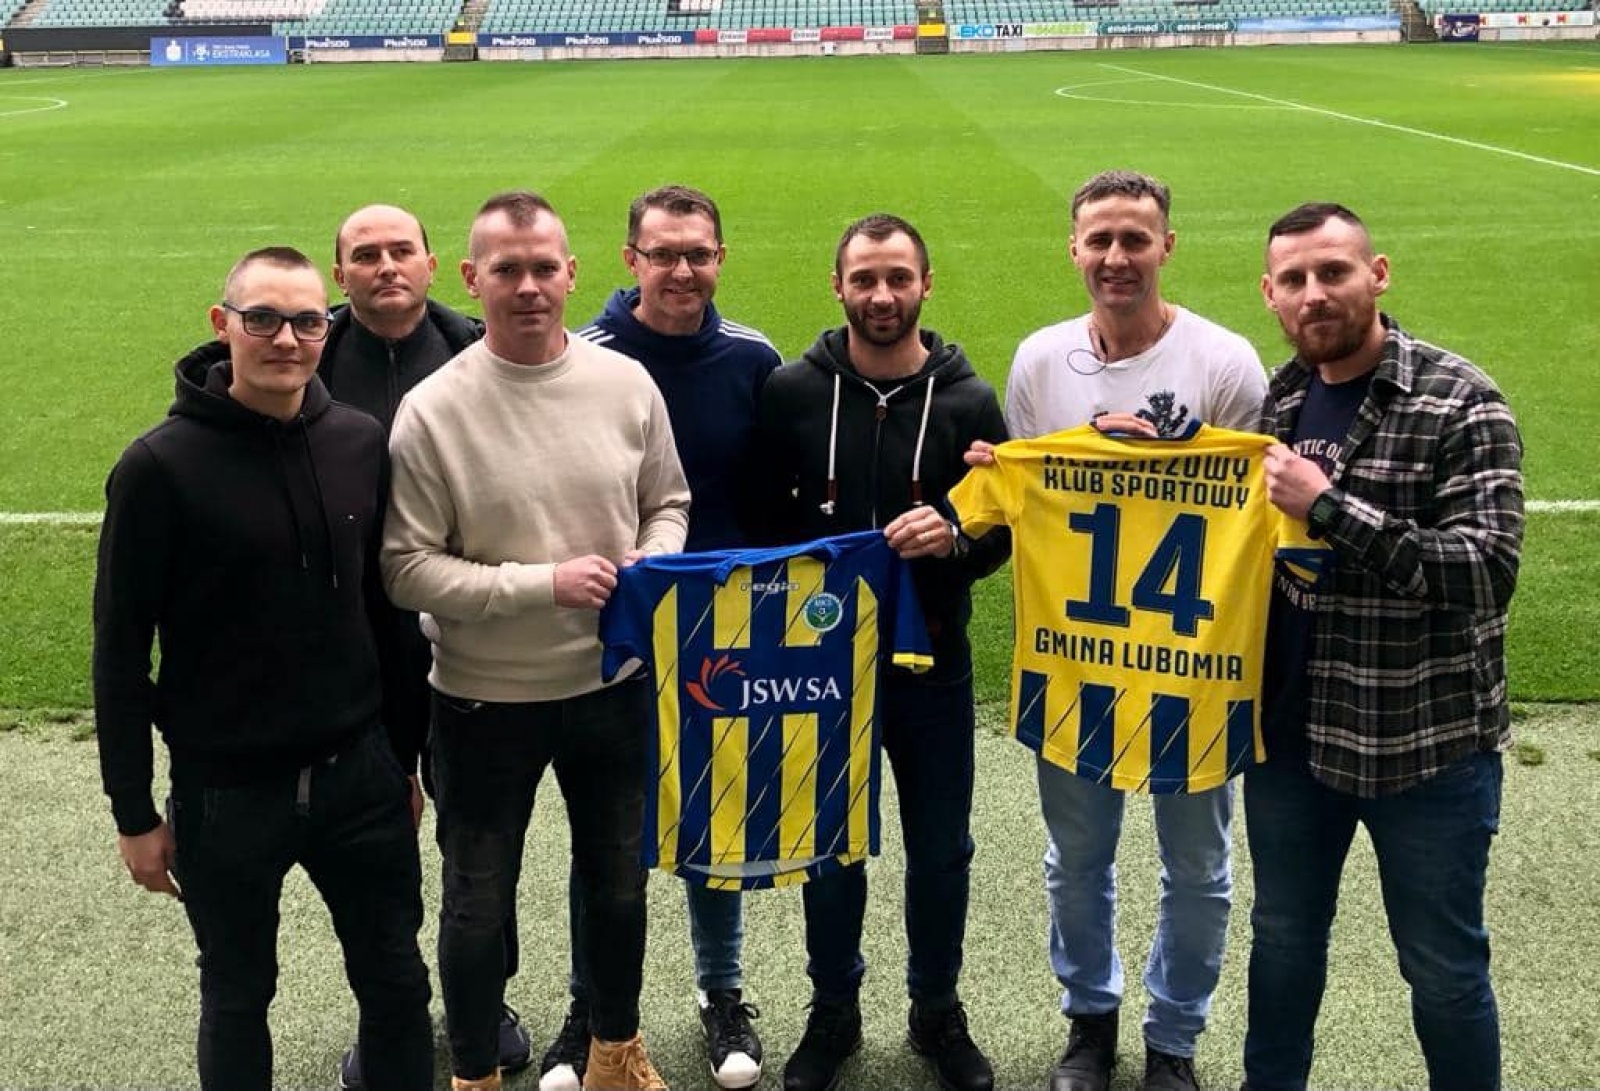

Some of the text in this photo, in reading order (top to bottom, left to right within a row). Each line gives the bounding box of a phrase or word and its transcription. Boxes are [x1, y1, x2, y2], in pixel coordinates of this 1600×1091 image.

[565, 34, 609, 45] Plus500
[638, 33, 682, 44] Plus500
[1044, 468, 1250, 510] KLUB SPORTOWY
[1066, 502, 1215, 638] 14
[1035, 627, 1244, 681] GMINA LUBOMIA
[739, 676, 842, 710] JSW SA
